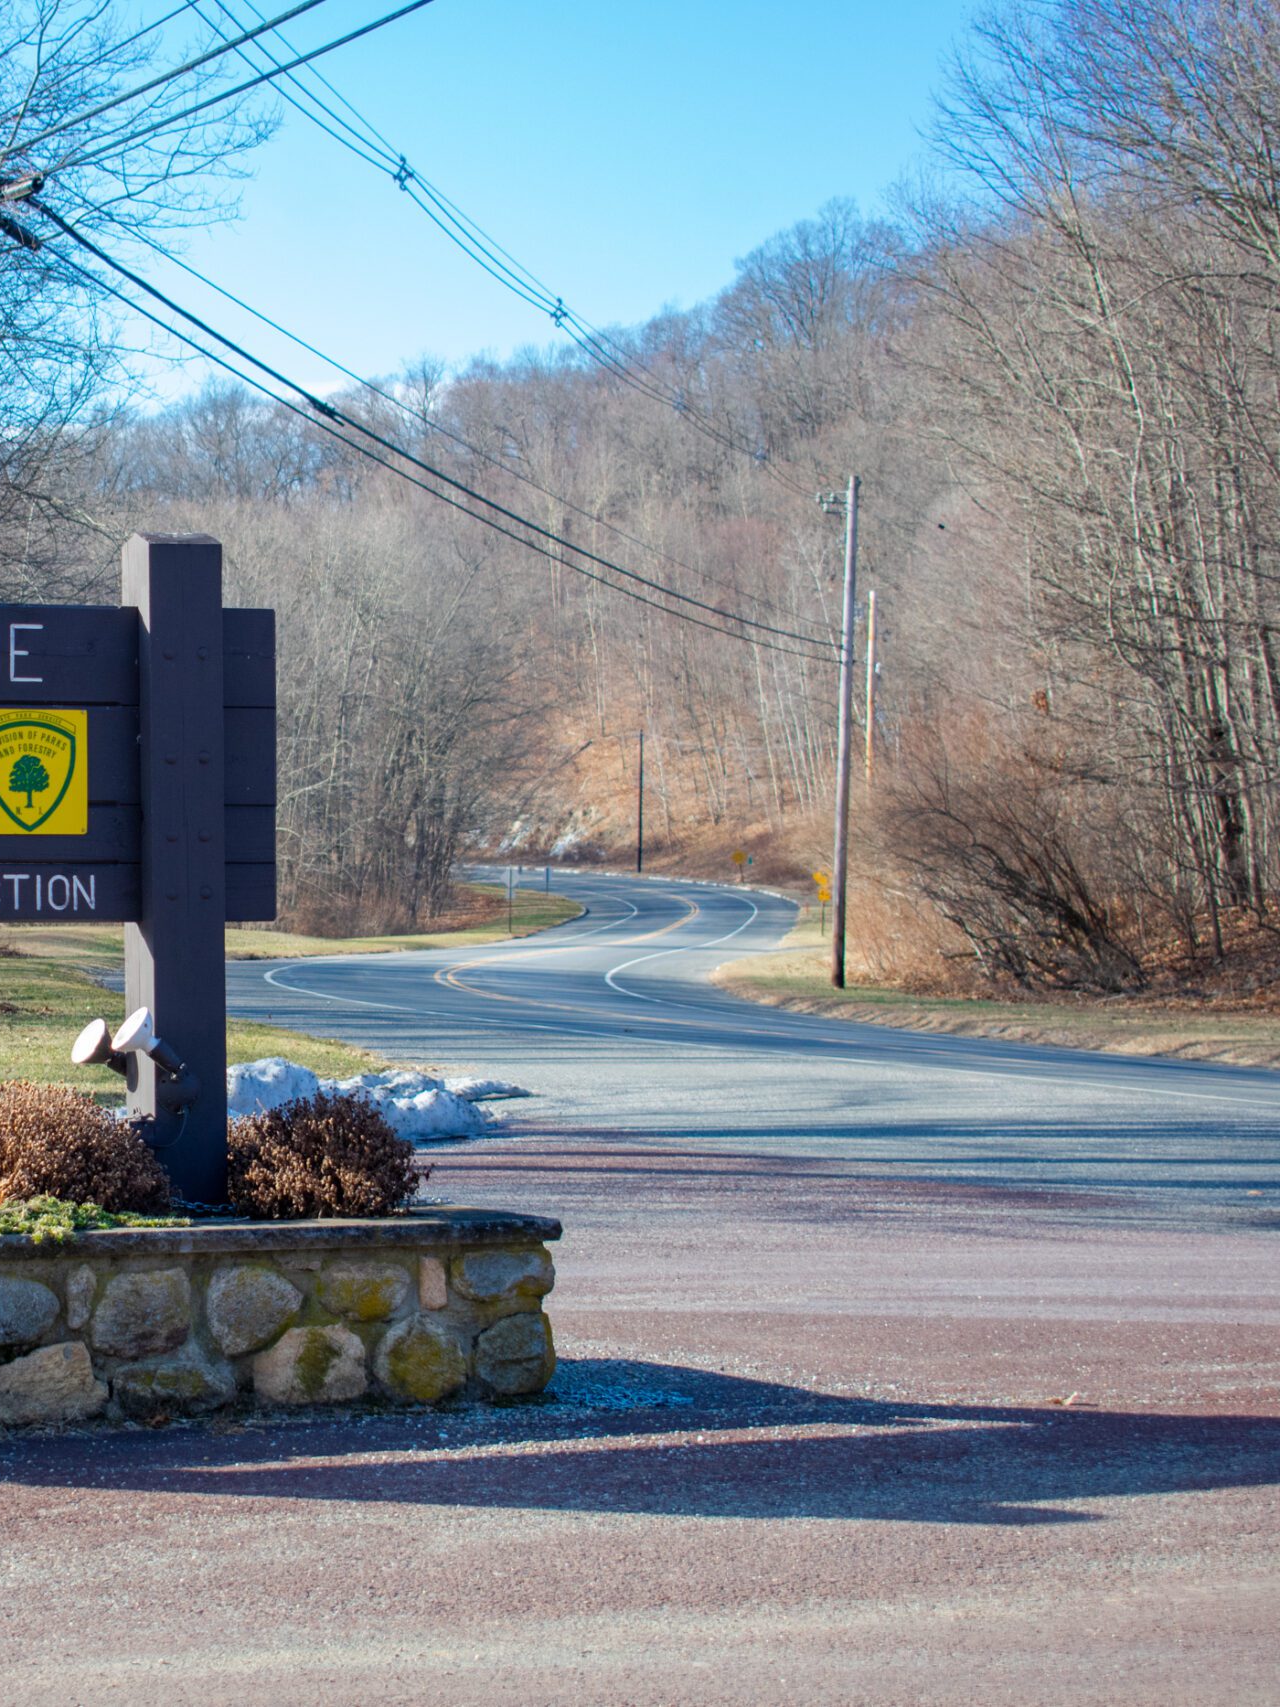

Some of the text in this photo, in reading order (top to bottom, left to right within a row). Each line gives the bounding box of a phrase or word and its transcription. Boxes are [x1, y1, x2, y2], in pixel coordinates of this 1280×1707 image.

[27, 731, 37, 740] OF
[40, 732, 68, 752] PARKS
[18, 743, 58, 760] FORESTRY
